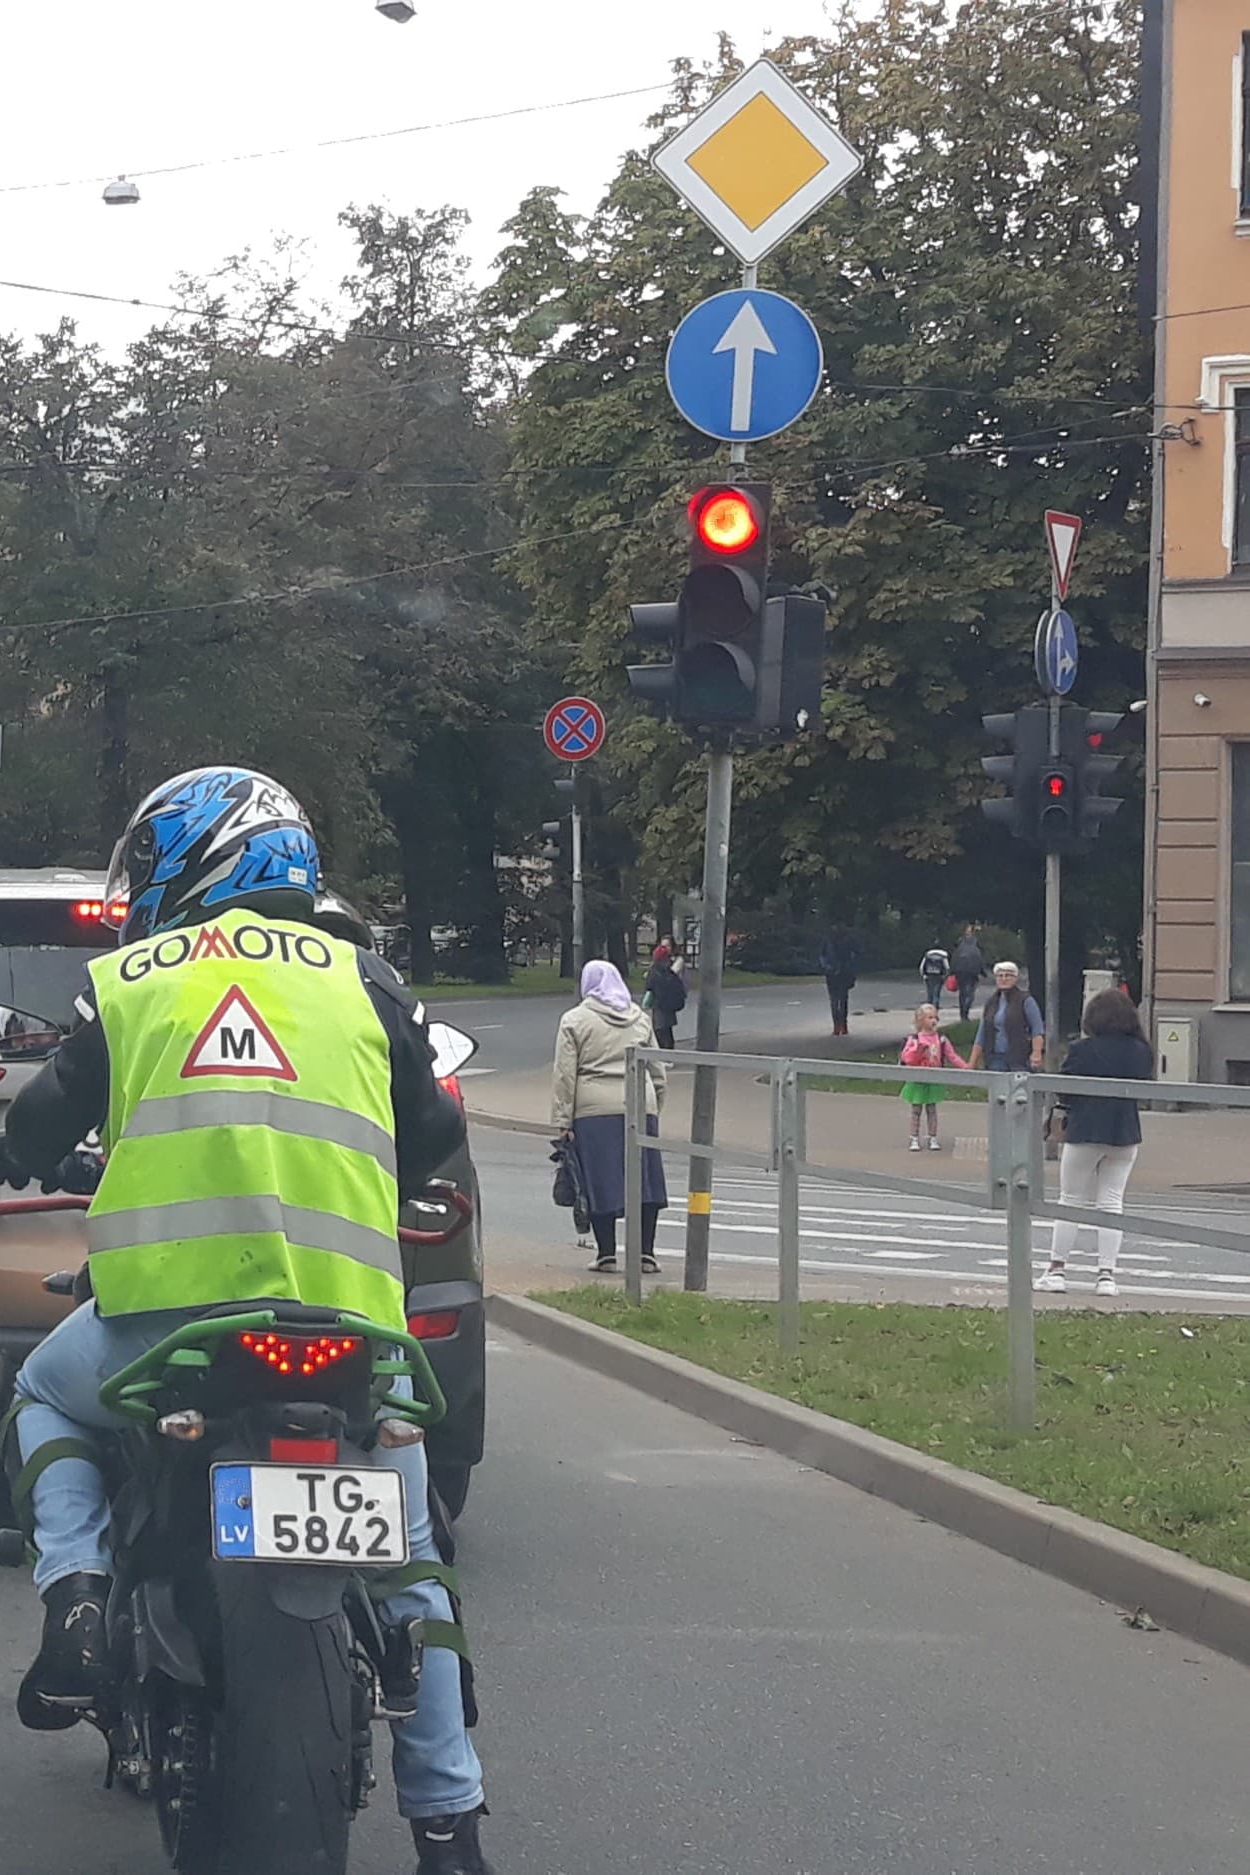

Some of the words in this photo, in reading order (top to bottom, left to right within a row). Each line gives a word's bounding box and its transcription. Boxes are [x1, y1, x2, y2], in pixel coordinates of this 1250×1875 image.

[120, 925, 332, 982] GOMOTO
[220, 1027, 256, 1060] M
[220, 1525, 248, 1543] LV
[273, 1514, 391, 1557] 5842
